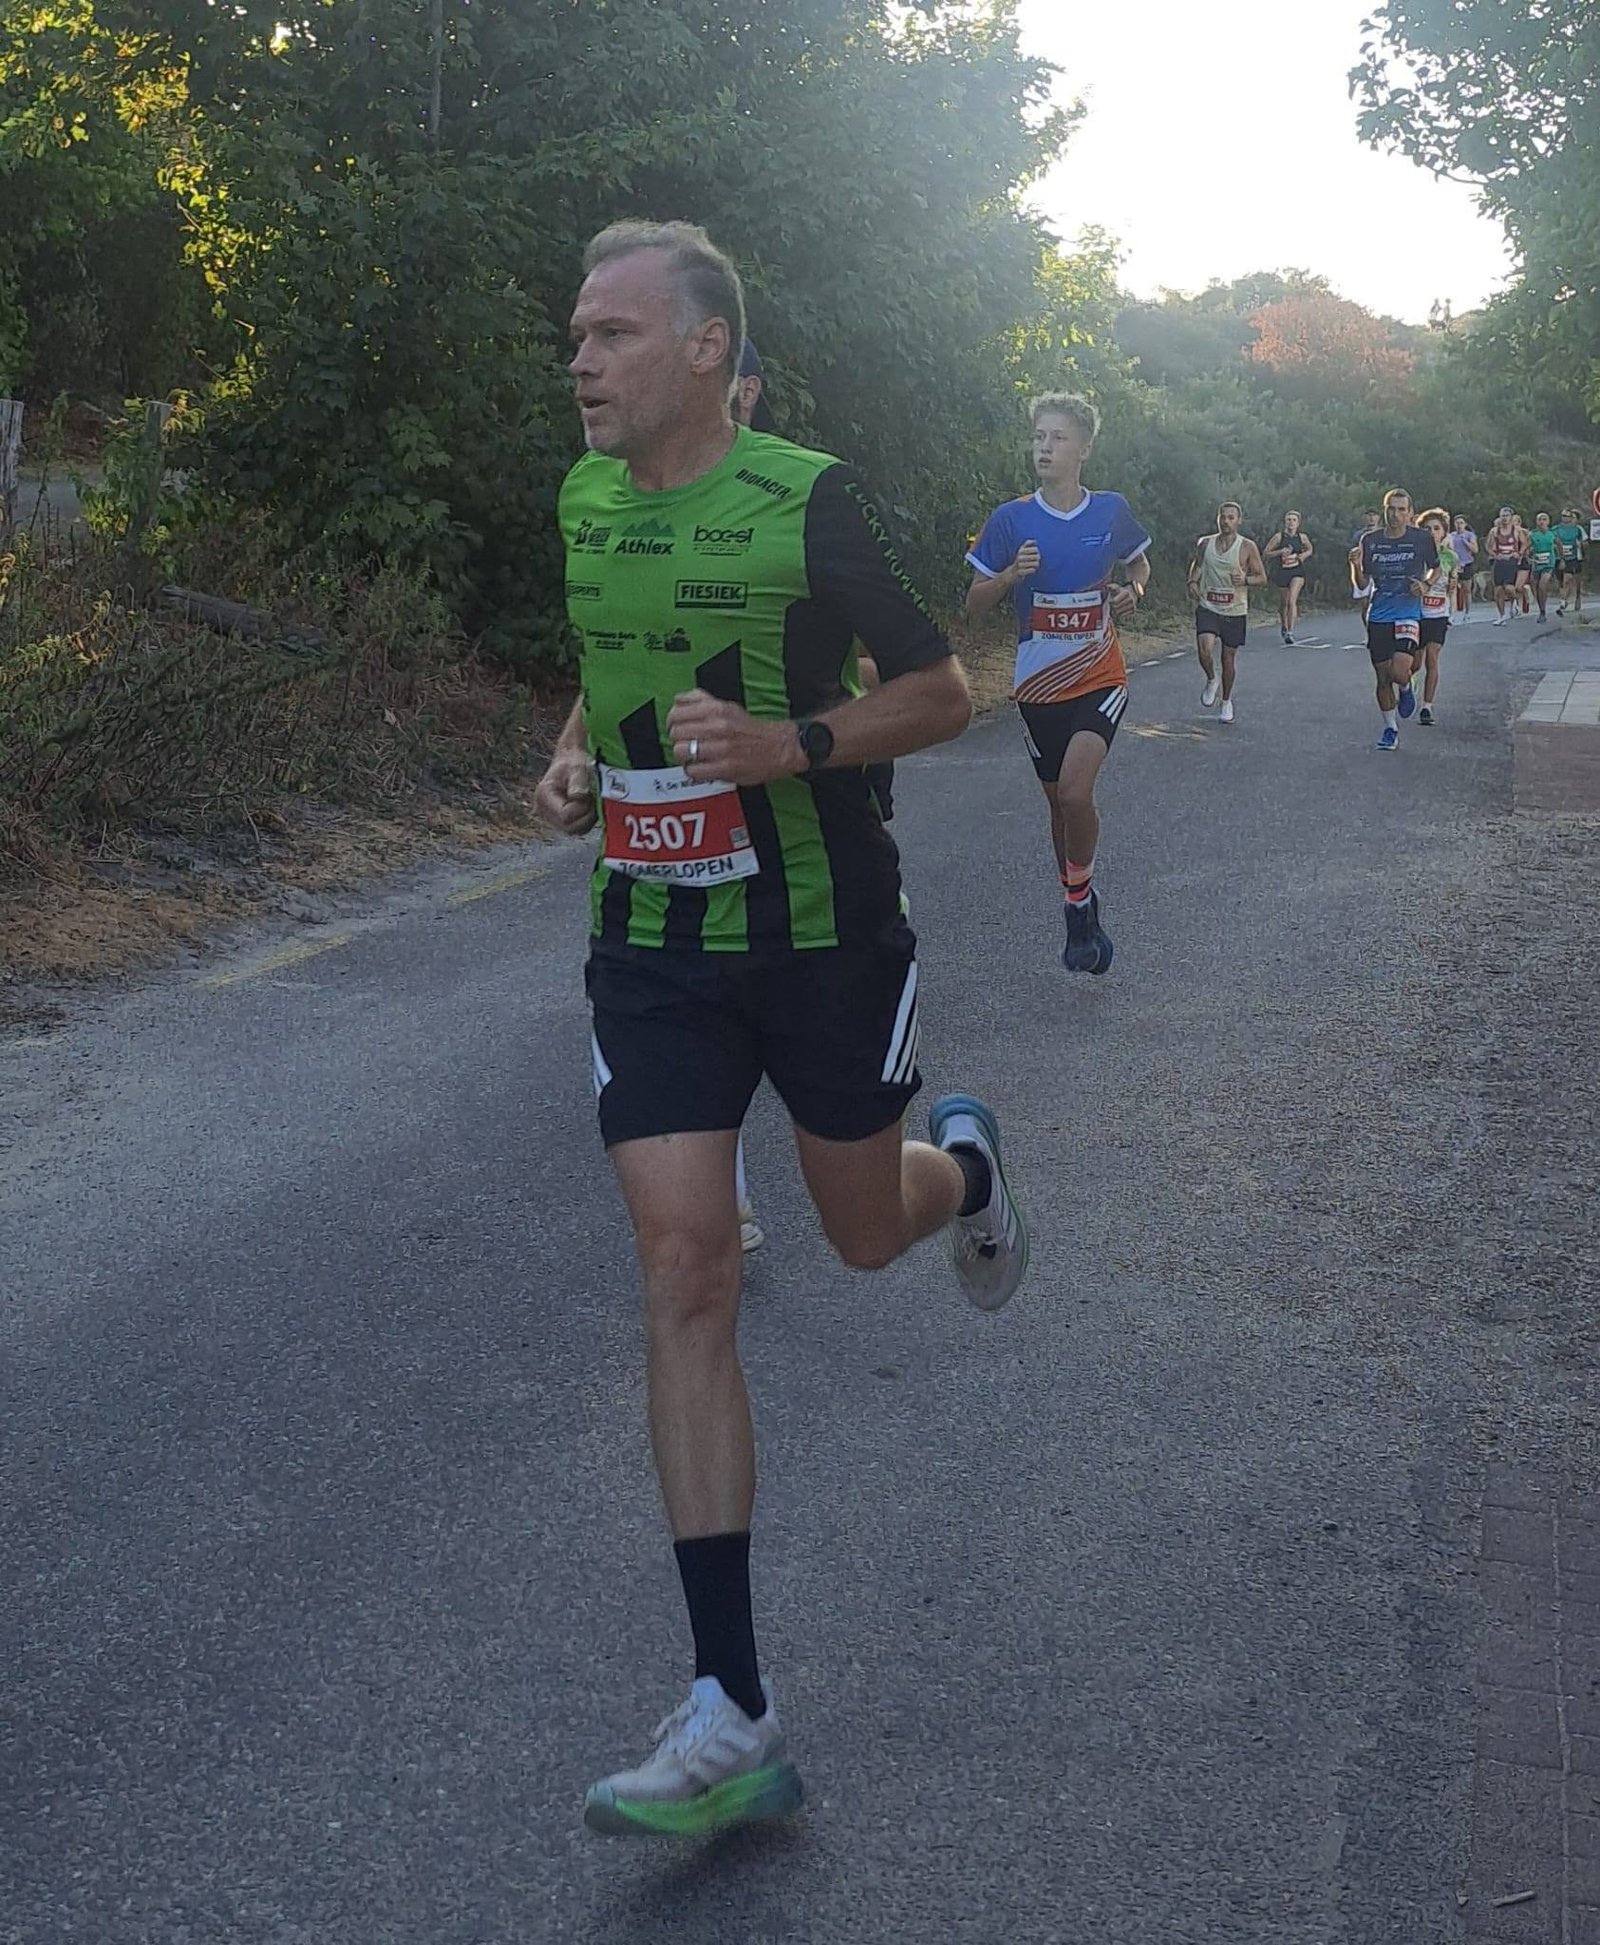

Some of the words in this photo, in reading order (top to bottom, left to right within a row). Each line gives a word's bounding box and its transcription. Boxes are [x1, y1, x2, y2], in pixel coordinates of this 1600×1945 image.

[844, 482, 889, 543] LUCKY
[614, 538, 676, 556] Athlex
[680, 583, 742, 600] FIESIEK
[1047, 611, 1091, 629] 1347
[1041, 631, 1096, 641] ZOMERLOPEN
[623, 810, 706, 853] 2507
